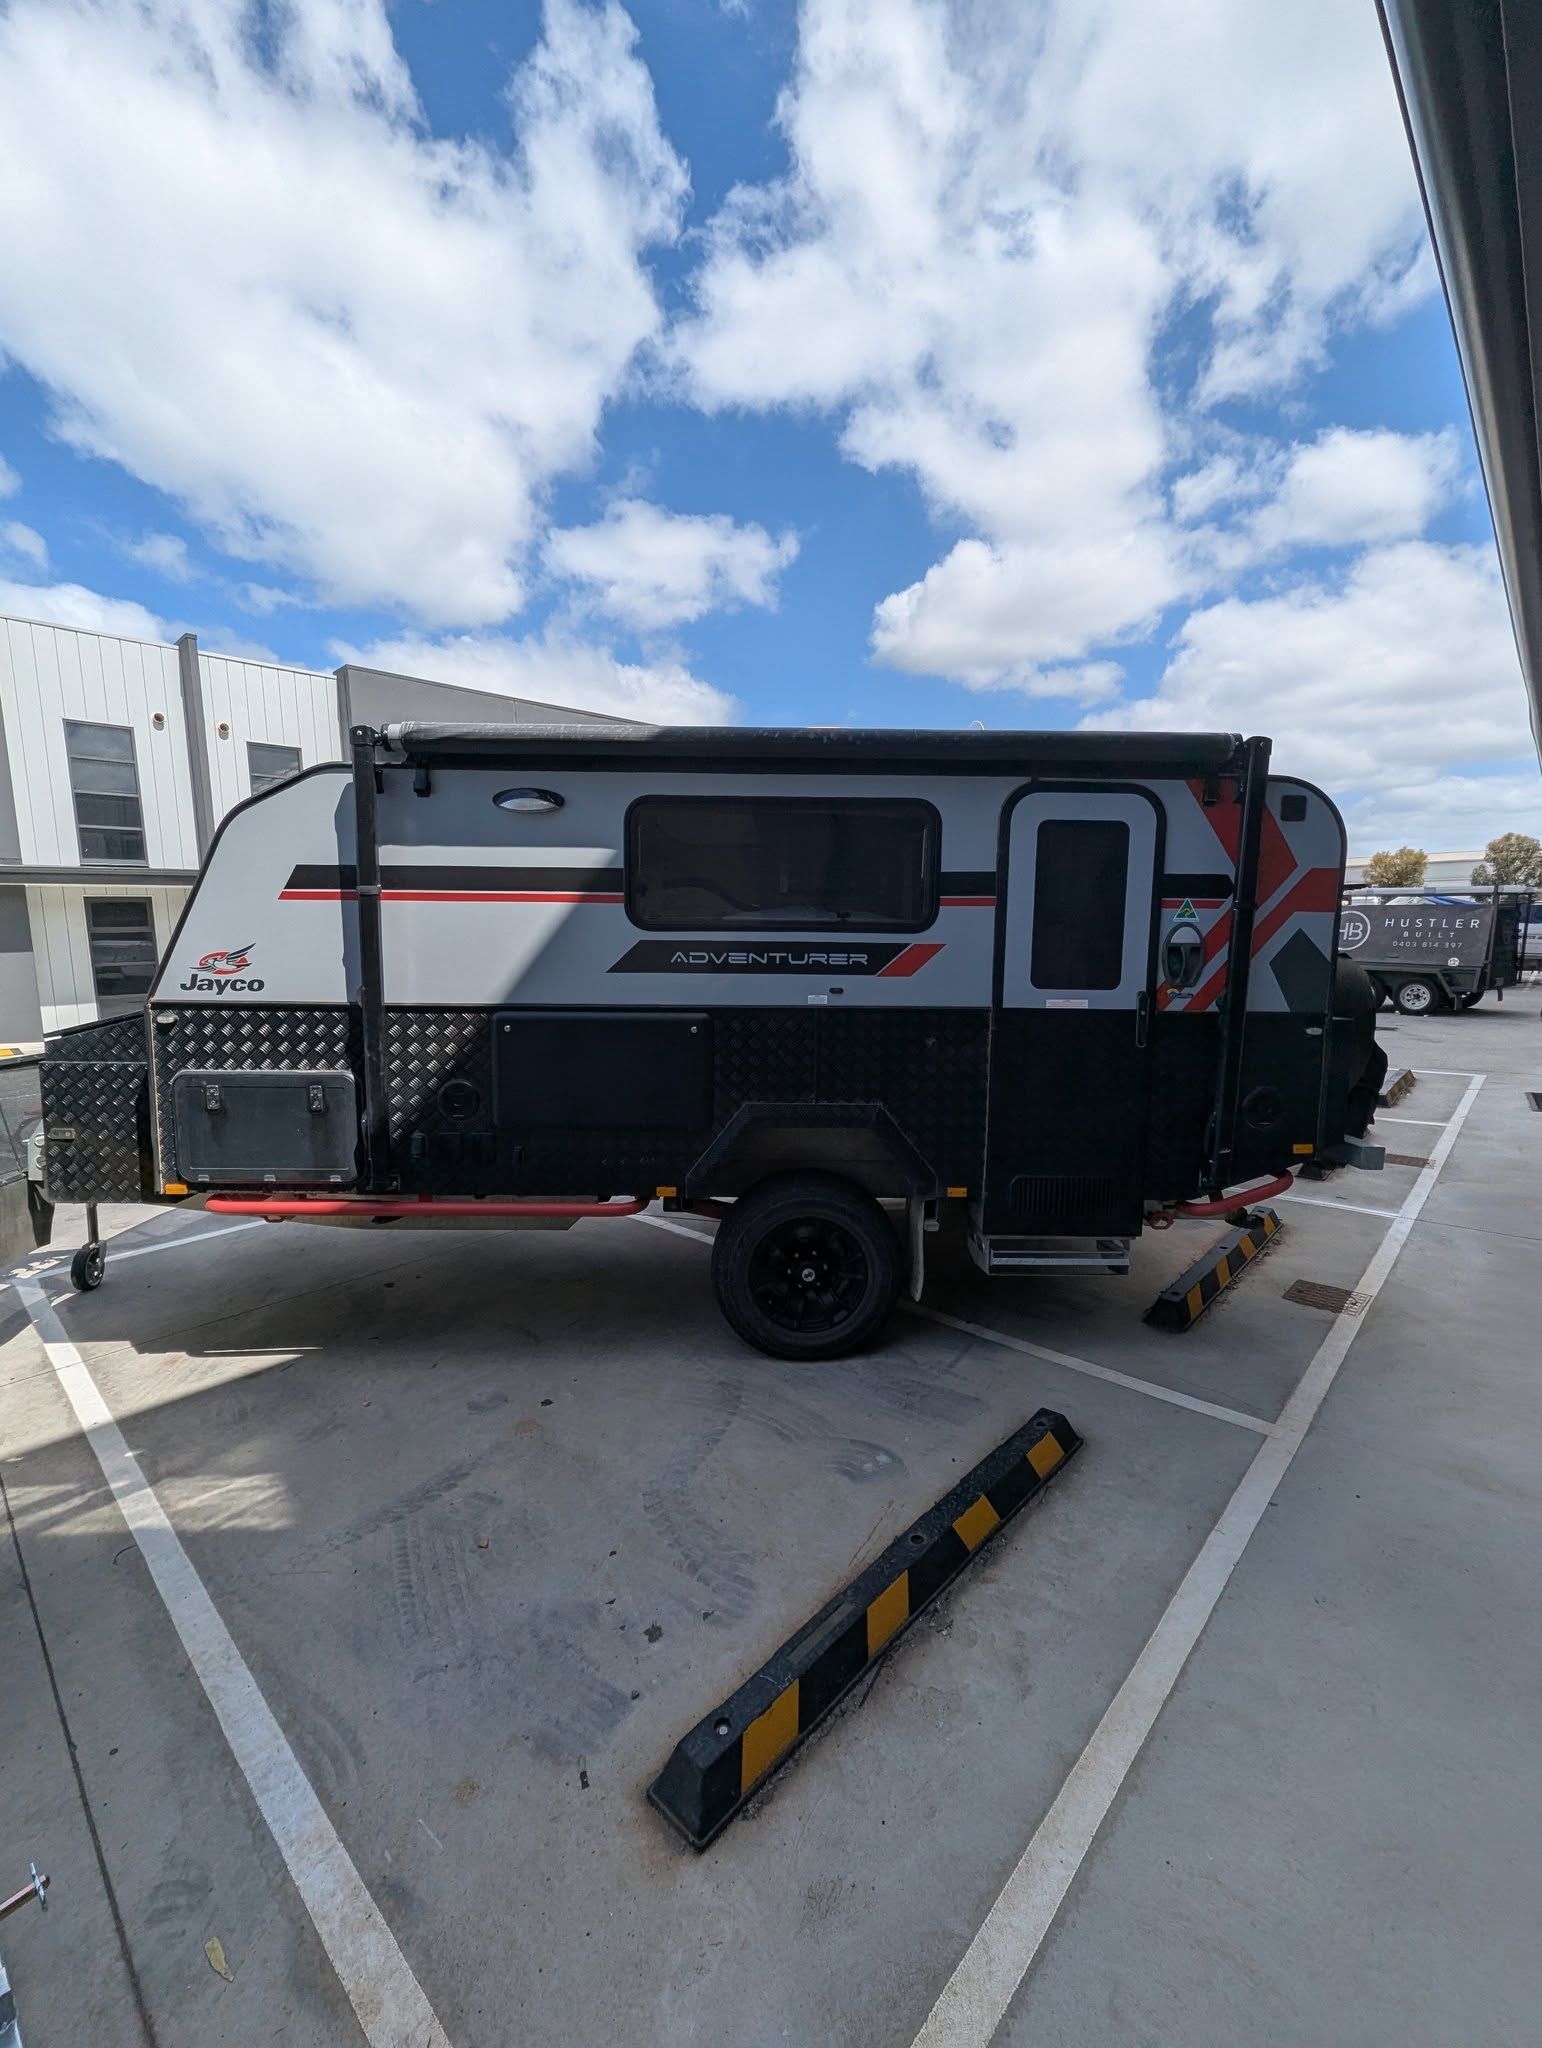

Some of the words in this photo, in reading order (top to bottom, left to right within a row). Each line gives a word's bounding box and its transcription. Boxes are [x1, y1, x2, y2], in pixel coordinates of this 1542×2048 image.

[1384, 918, 1480, 928] HUSTLER
[670, 951, 869, 965] ADVENTURER
[180, 973, 265, 996] Jayco
